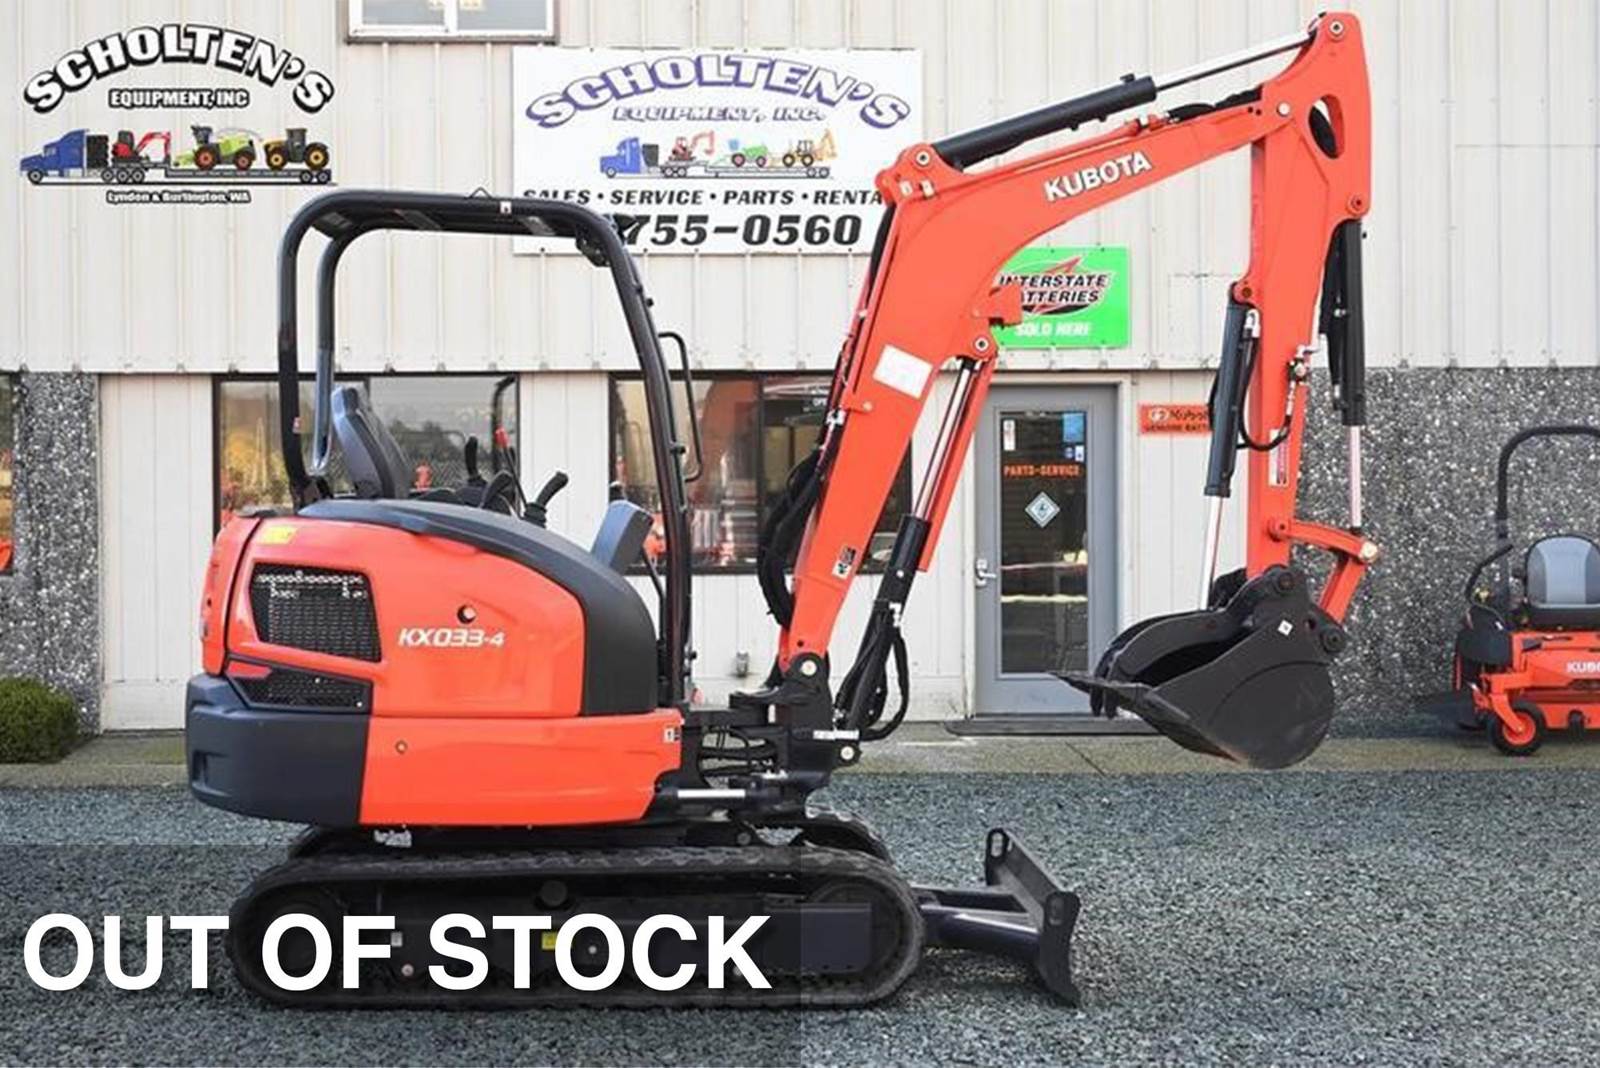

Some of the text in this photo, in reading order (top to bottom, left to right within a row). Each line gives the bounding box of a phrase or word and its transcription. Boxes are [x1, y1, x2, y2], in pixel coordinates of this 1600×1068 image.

[612, 106, 825, 122] EQUIPMENT, INC.
[1044, 151, 1151, 200] KUBOTA
[610, 190, 703, 205] SERVICE
[723, 190, 794, 205] PARTS
[813, 190, 882, 205] RENTA
[624, 214, 861, 246] 755-0560
[1000, 274, 1107, 288] INTERSTATE
[1022, 290, 1099, 303] TTERIES
[398, 628, 505, 647] KX033-4
[1566, 661, 1600, 673] KUB
